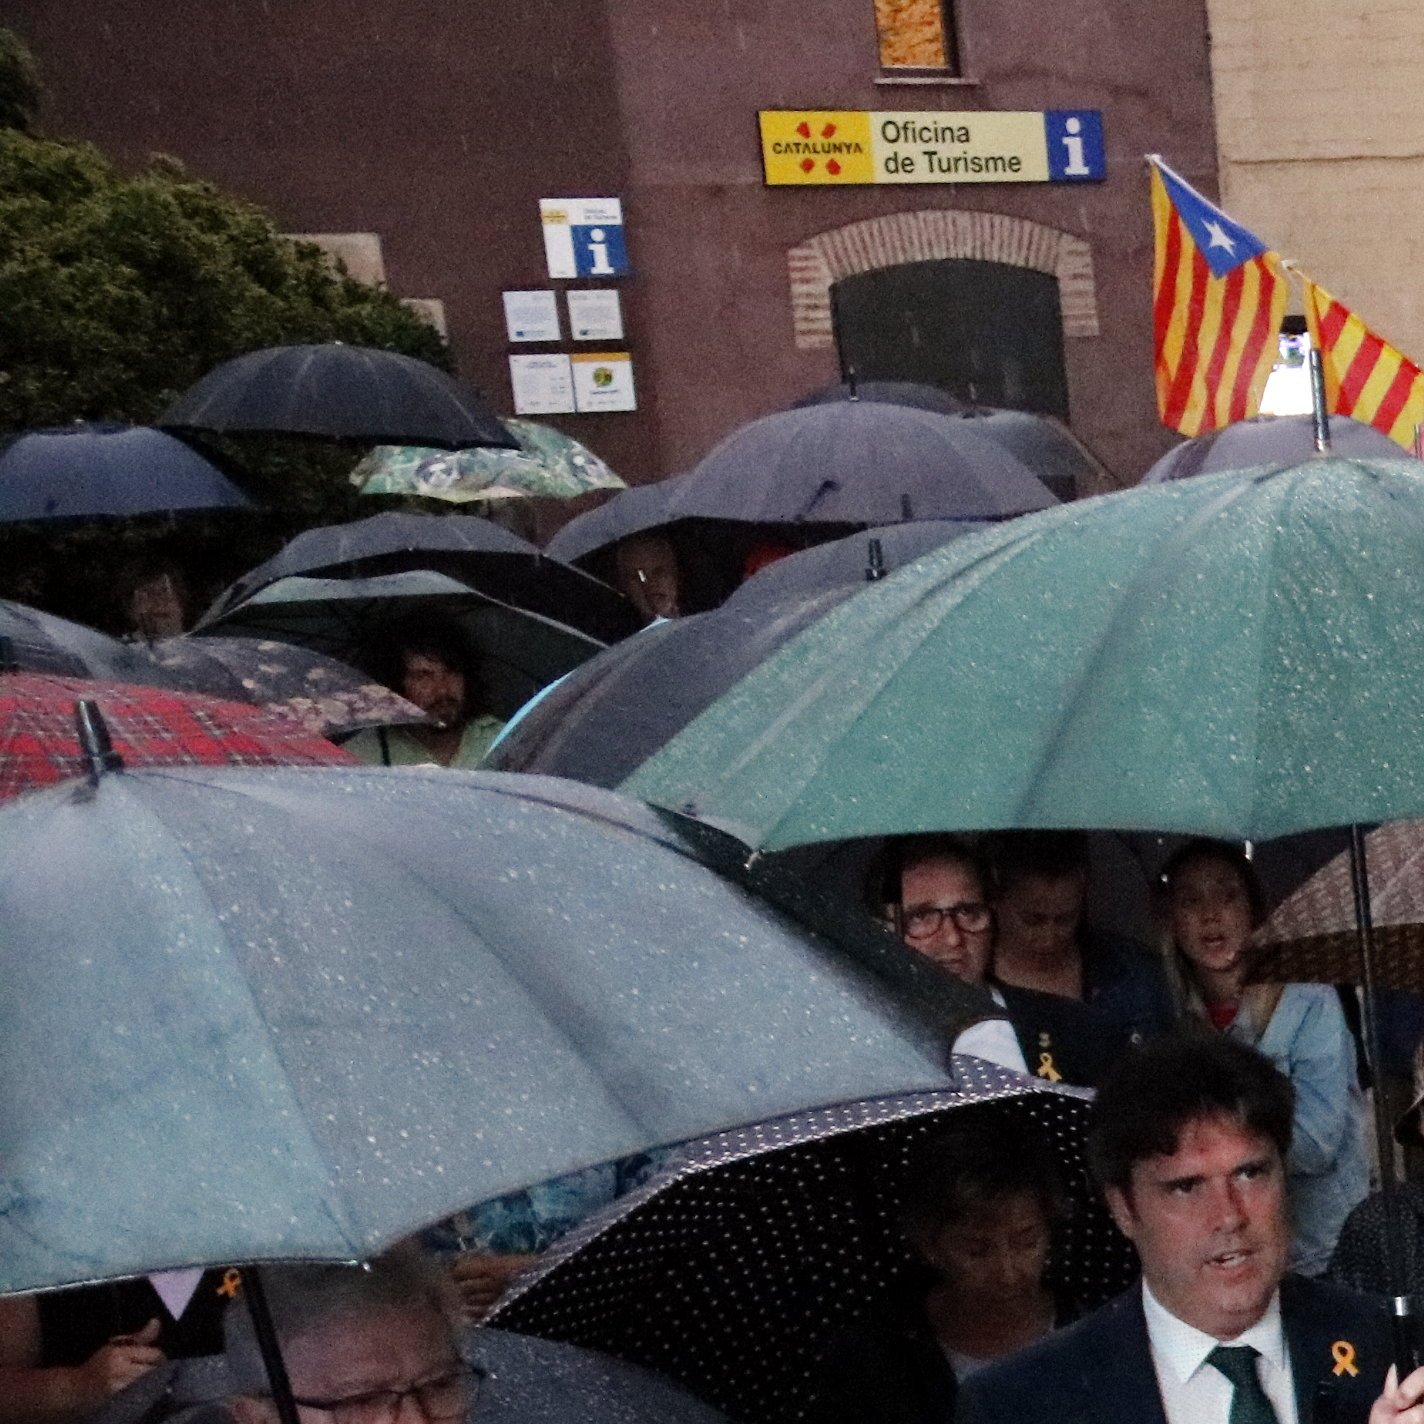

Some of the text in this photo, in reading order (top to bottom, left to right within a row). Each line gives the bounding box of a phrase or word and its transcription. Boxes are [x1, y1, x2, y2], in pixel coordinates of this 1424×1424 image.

[881, 119, 971, 144] Oficina
[772, 142, 863, 154] CATALUNYA
[1062, 117, 1090, 175] i
[884, 150, 1022, 174] de Turisme
